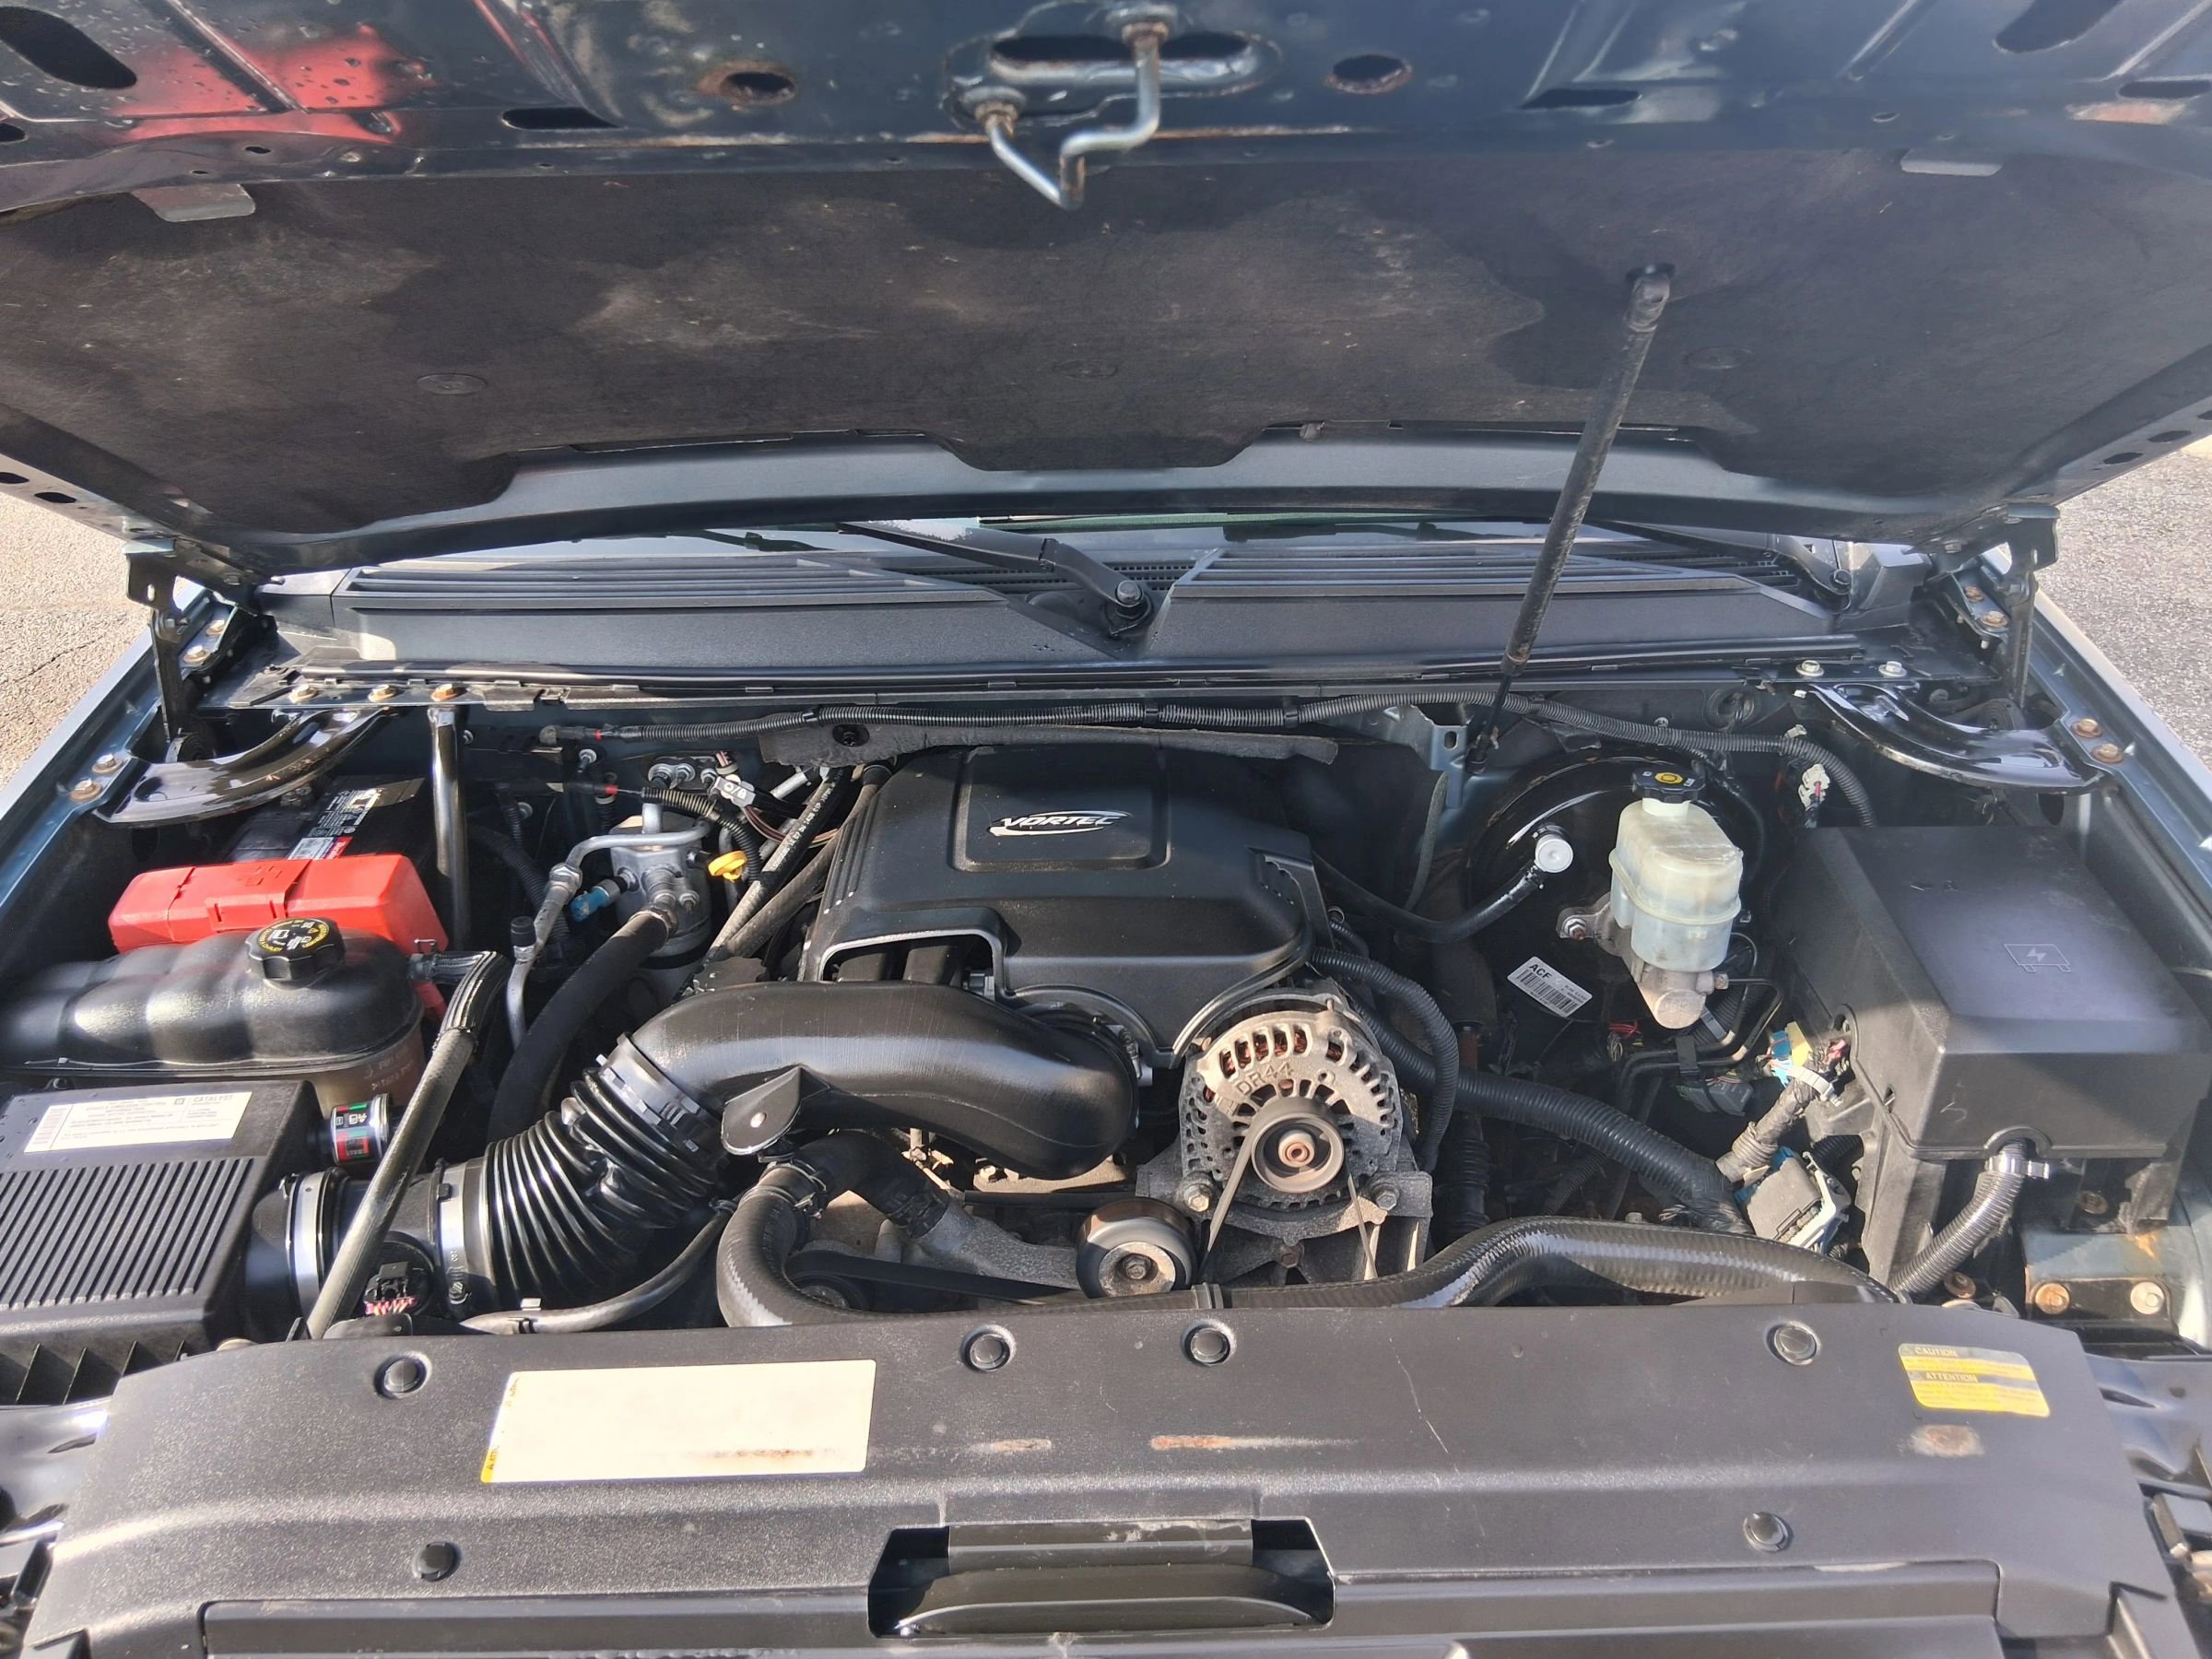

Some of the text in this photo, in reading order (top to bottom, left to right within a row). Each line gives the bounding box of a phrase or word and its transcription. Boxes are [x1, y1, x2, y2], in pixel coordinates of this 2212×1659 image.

[1001, 816, 1122, 828] VORTEC
[1528, 963, 1554, 980] ACF
[1915, 1347, 1959, 1358] CAUTION
[1924, 1371, 1979, 1382] ATTENTION
